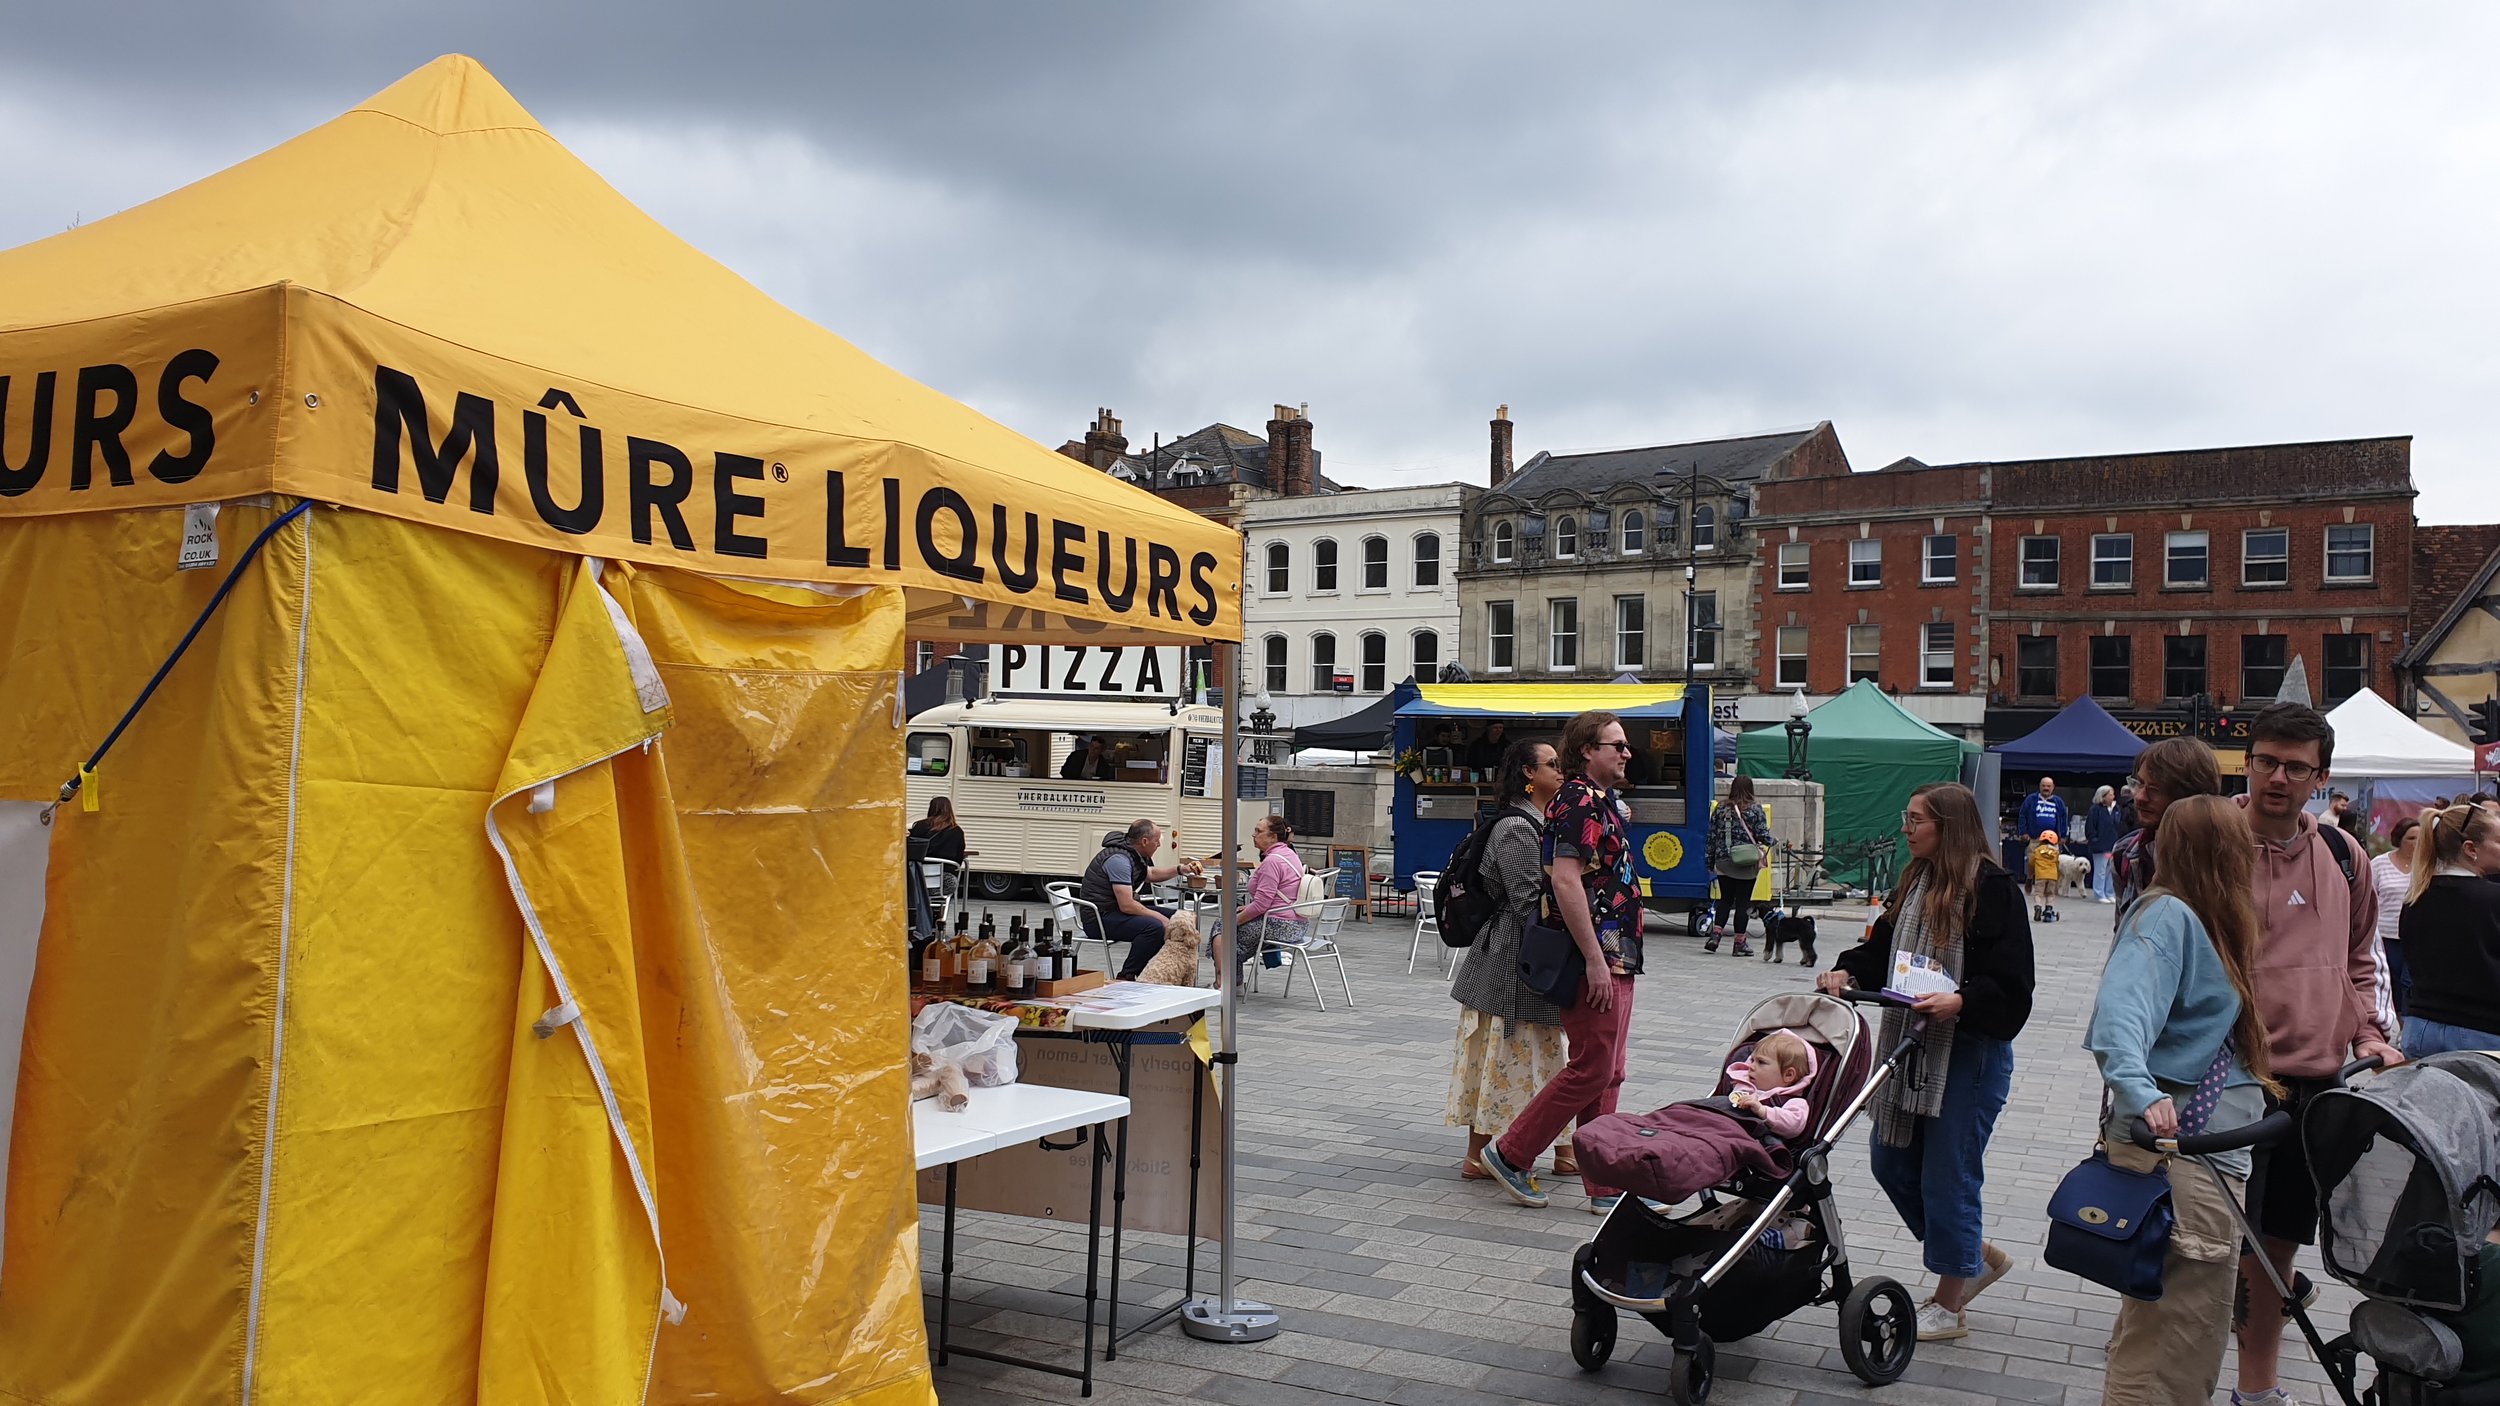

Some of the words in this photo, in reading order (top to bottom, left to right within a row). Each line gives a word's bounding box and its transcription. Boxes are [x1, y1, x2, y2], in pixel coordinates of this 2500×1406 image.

[186, 532, 213, 545] ROCK
[825, 470, 1218, 627] LIQUEURS
[184, 550, 212, 561] CO.UK
[1002, 644, 1164, 693] PIZZA
[1017, 791, 1106, 804] VHERBALKITCHEN
